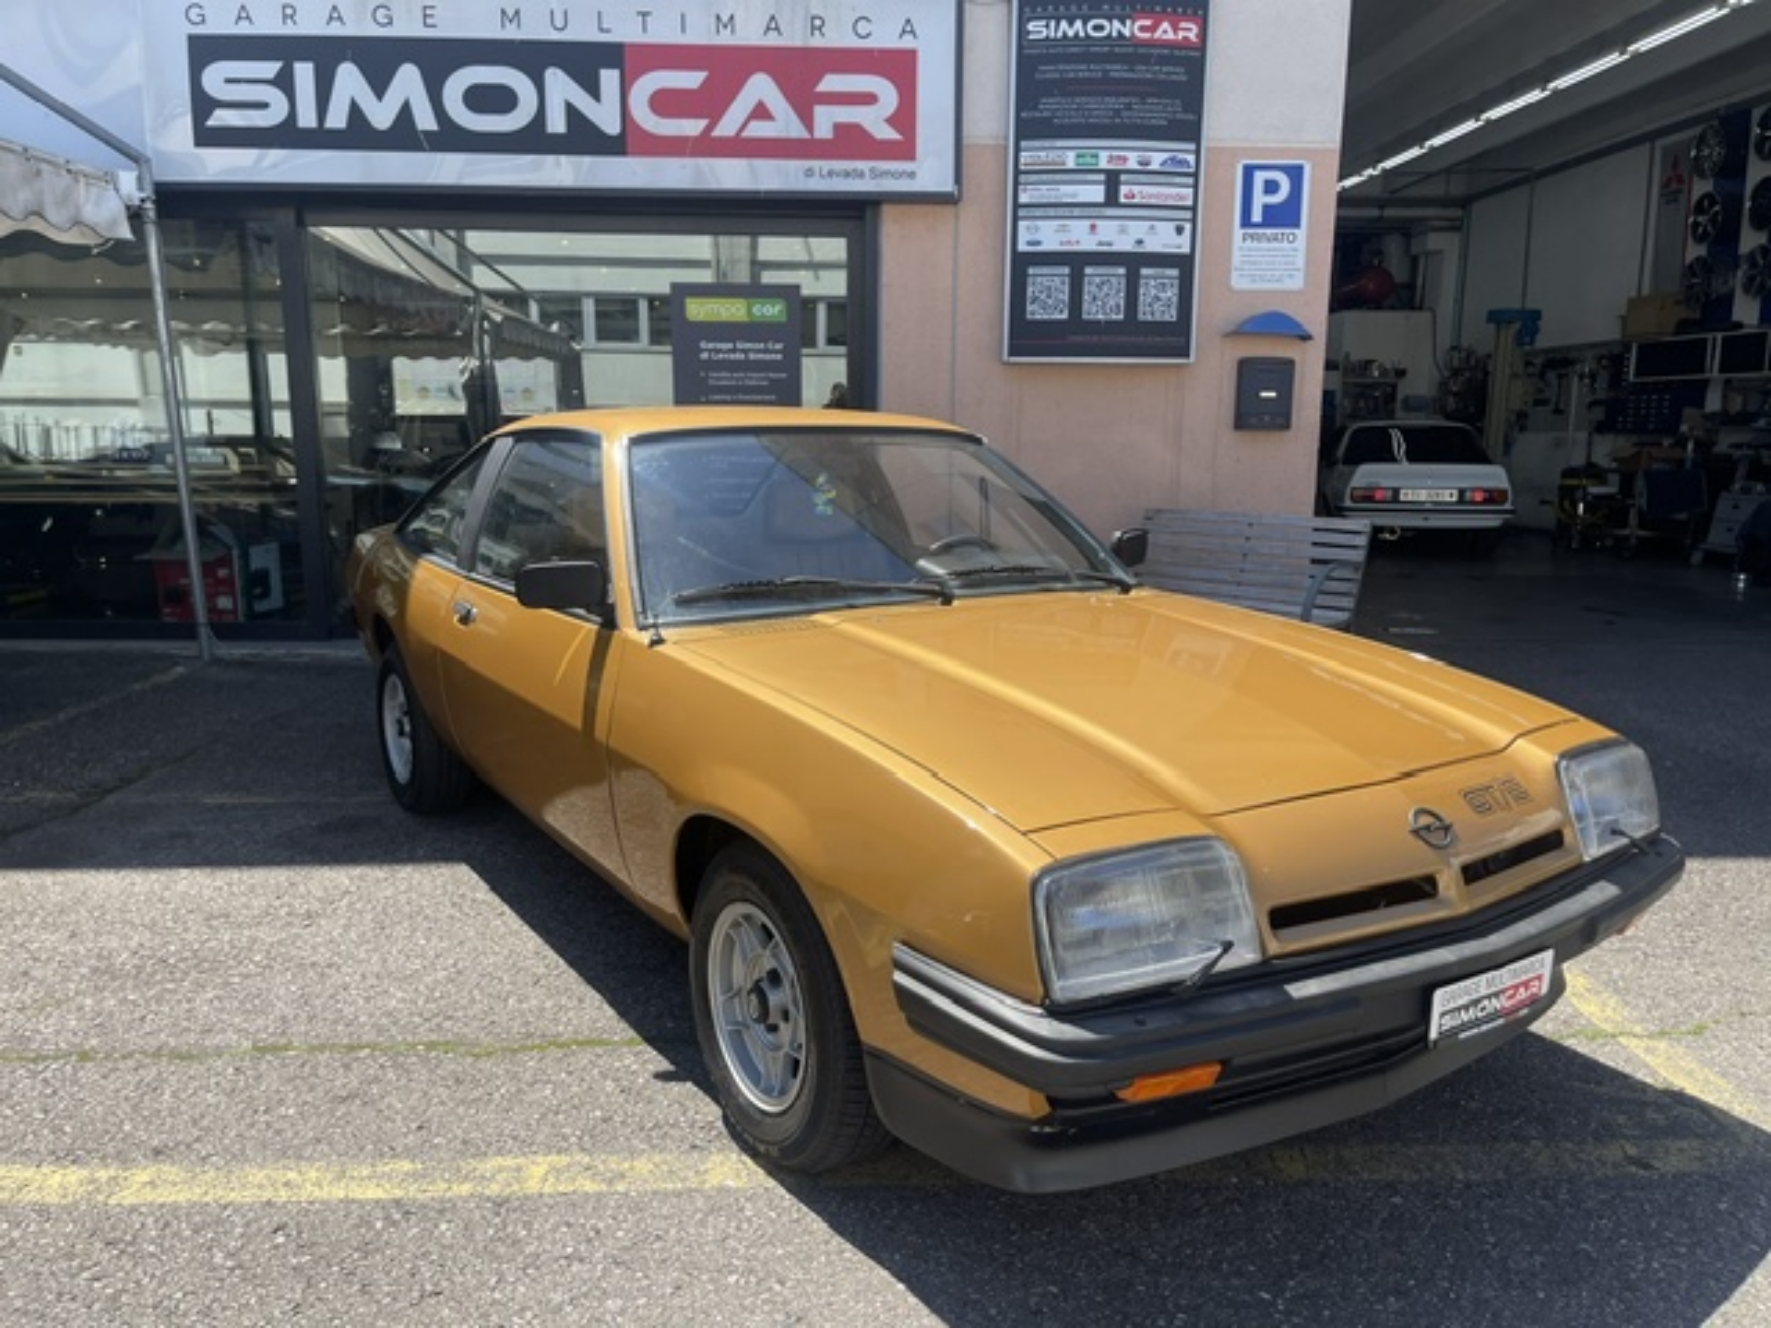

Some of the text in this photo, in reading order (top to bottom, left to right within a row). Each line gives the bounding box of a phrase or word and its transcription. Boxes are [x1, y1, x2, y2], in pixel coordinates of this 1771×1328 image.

[184, 4, 918, 40] GARAGE MULTIMARCA
[1026, 17, 1200, 42] SIMONCAR
[199, 60, 904, 142] SIMONCAR
[818, 165, 866, 180] Levada
[868, 166, 917, 180] Simone
[1250, 169, 1291, 223] P
[1242, 232, 1298, 244] PRIVATO
